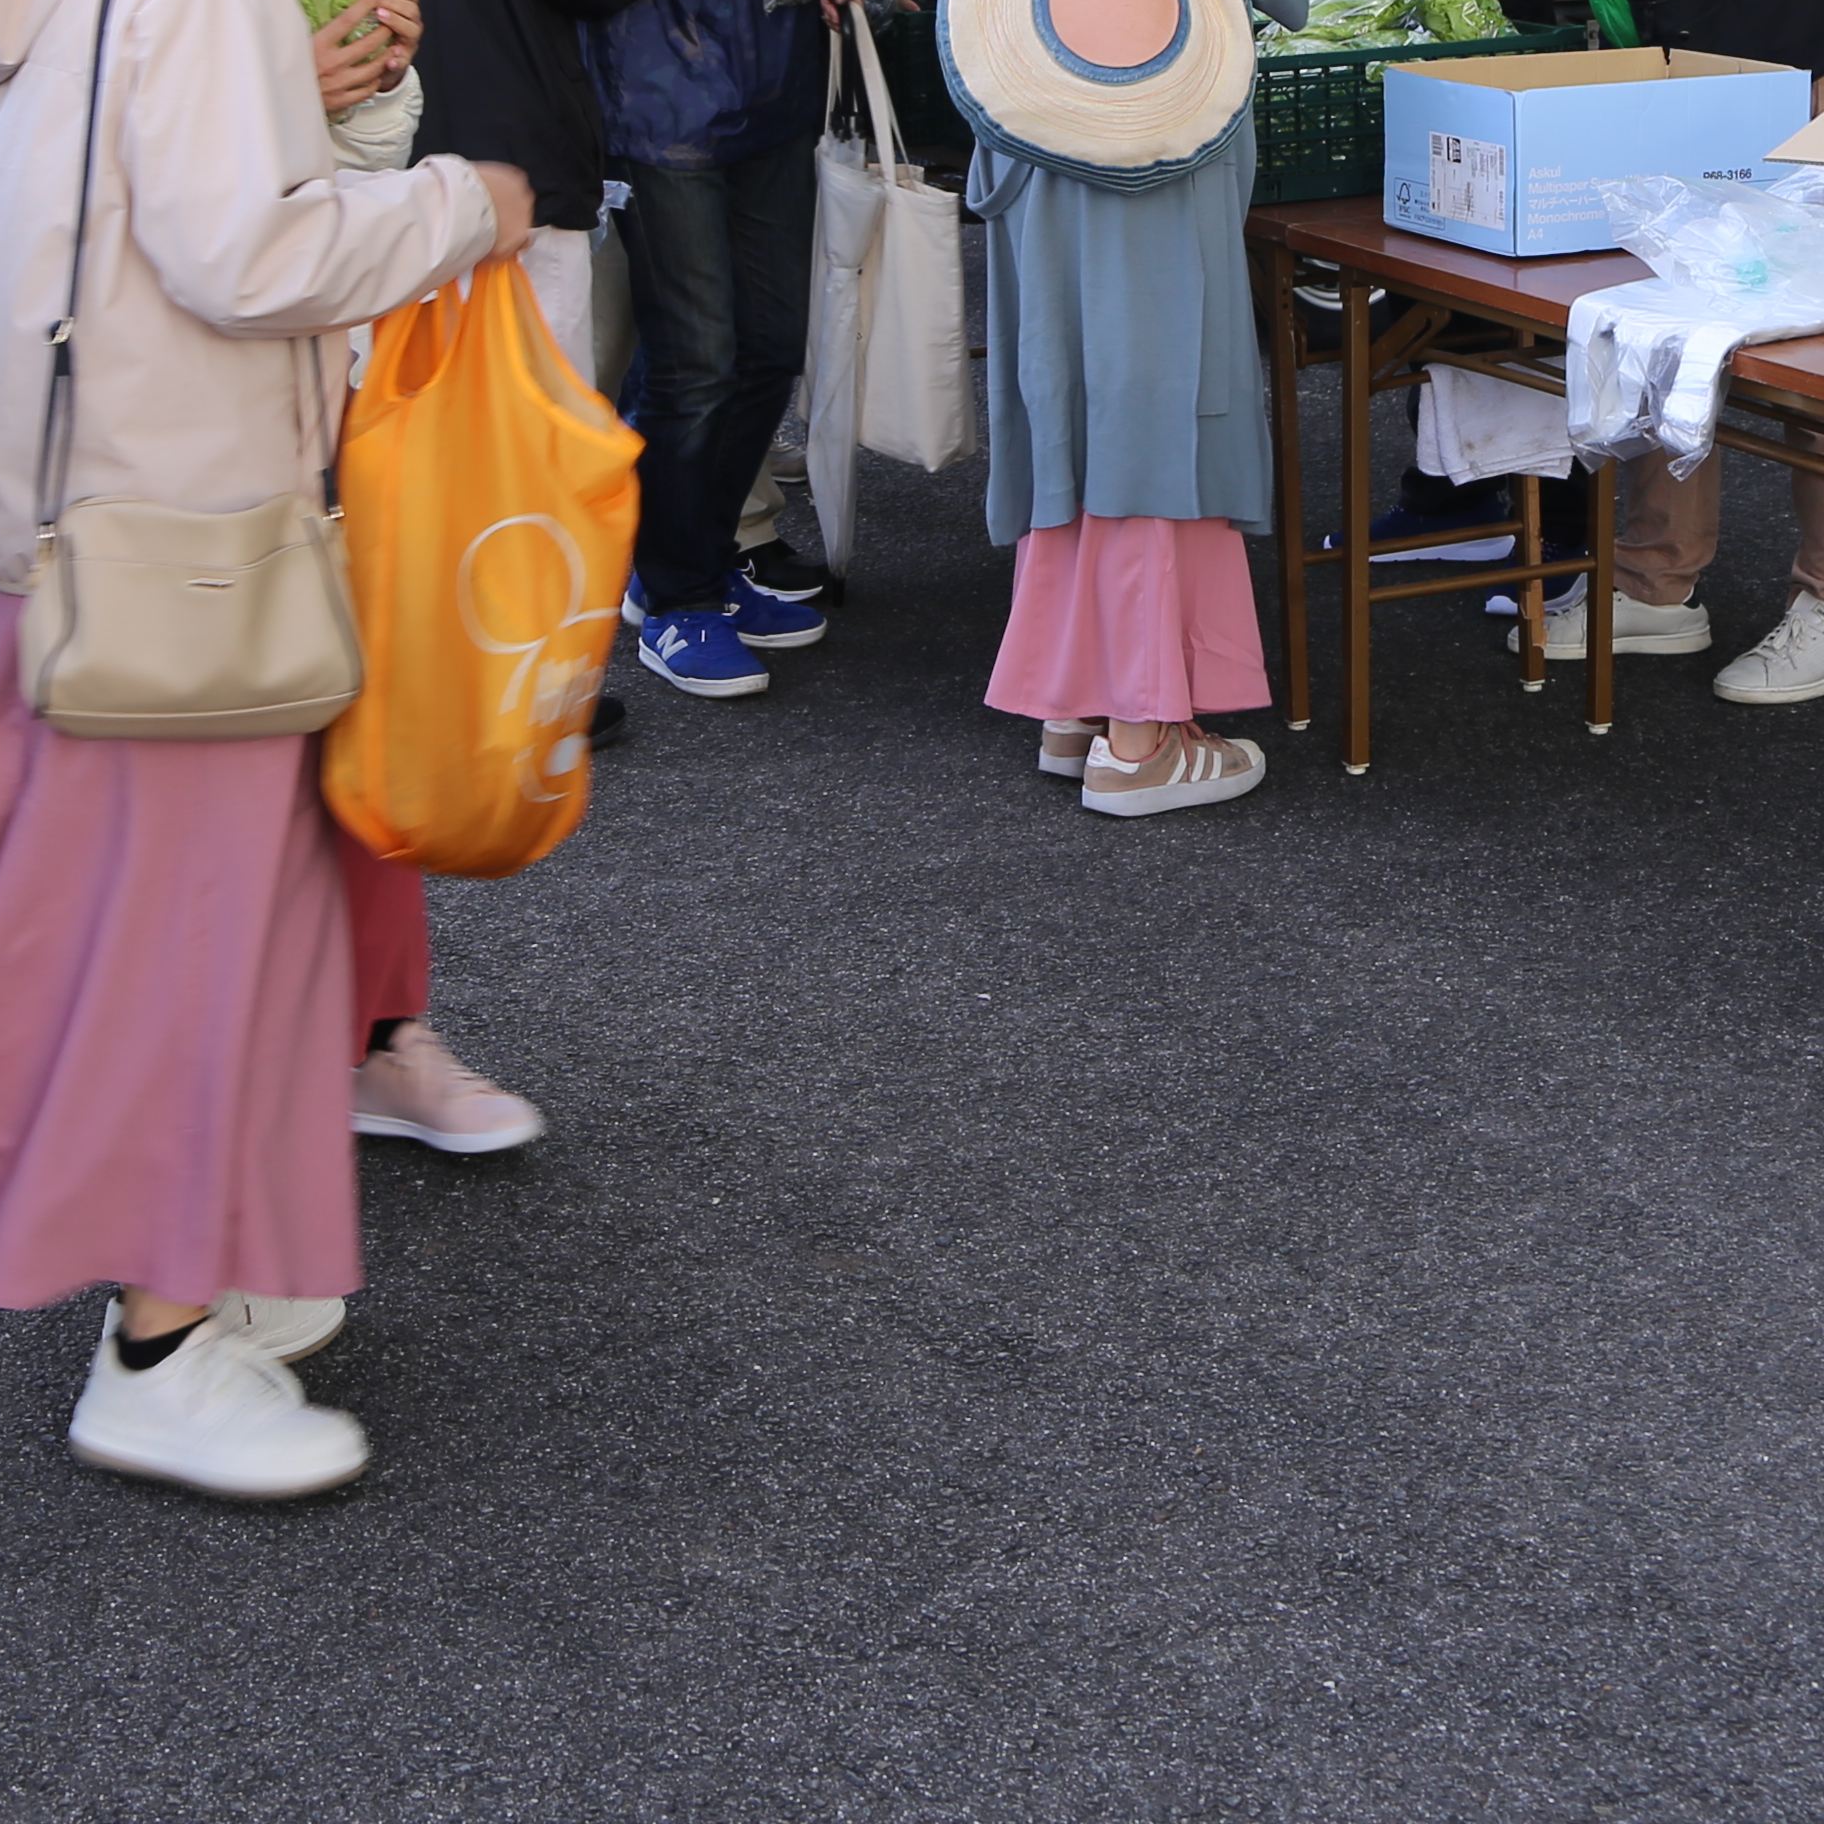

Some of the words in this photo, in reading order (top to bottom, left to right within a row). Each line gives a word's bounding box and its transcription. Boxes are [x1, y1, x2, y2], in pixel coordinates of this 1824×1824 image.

[1528, 166, 1561, 179] Askul
[1528, 180, 1589, 194] Multipaper
[1527, 209, 1606, 225] Monochrome
[1527, 228, 1544, 241] A4
